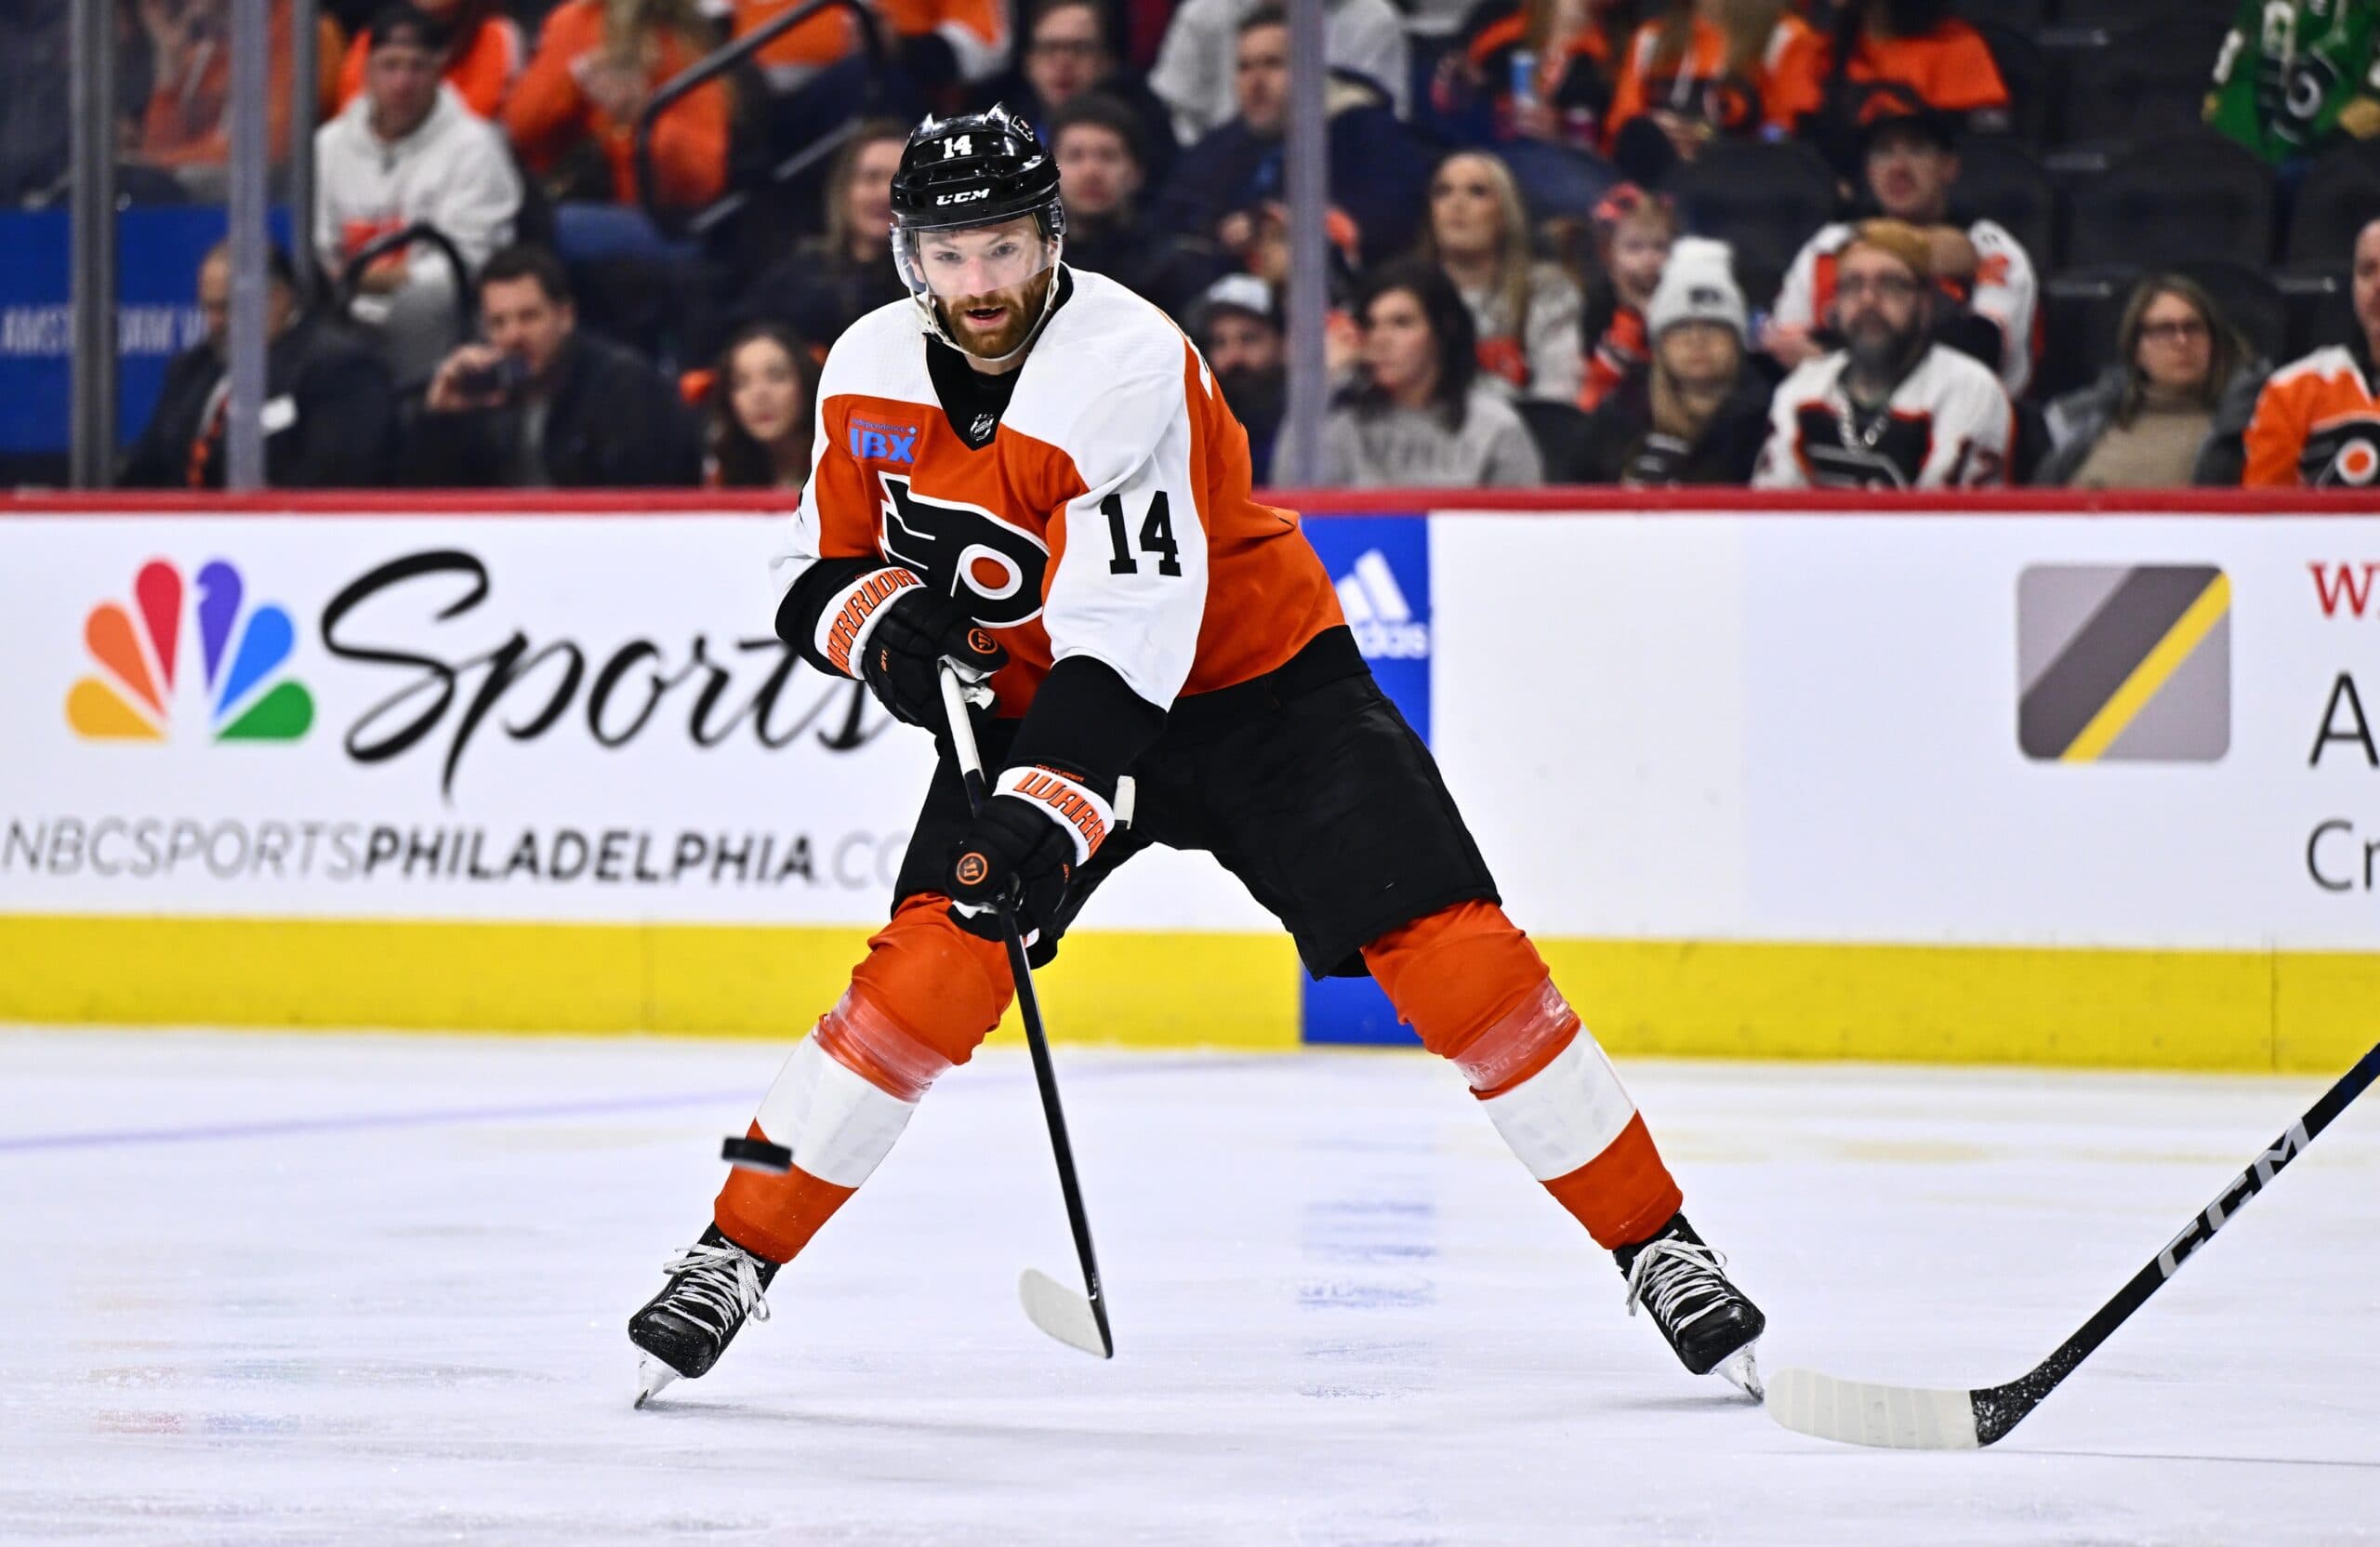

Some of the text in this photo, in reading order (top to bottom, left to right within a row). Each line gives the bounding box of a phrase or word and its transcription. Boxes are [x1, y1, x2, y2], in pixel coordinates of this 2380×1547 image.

[943, 134, 972, 159] 14
[936, 188, 990, 205] CCM
[850, 428, 916, 464] IBX
[1099, 490, 1183, 577] 14
[2307, 560, 2380, 620] W
[319, 549, 896, 809] Sports
[2157, 1117, 2312, 1280] CCM
